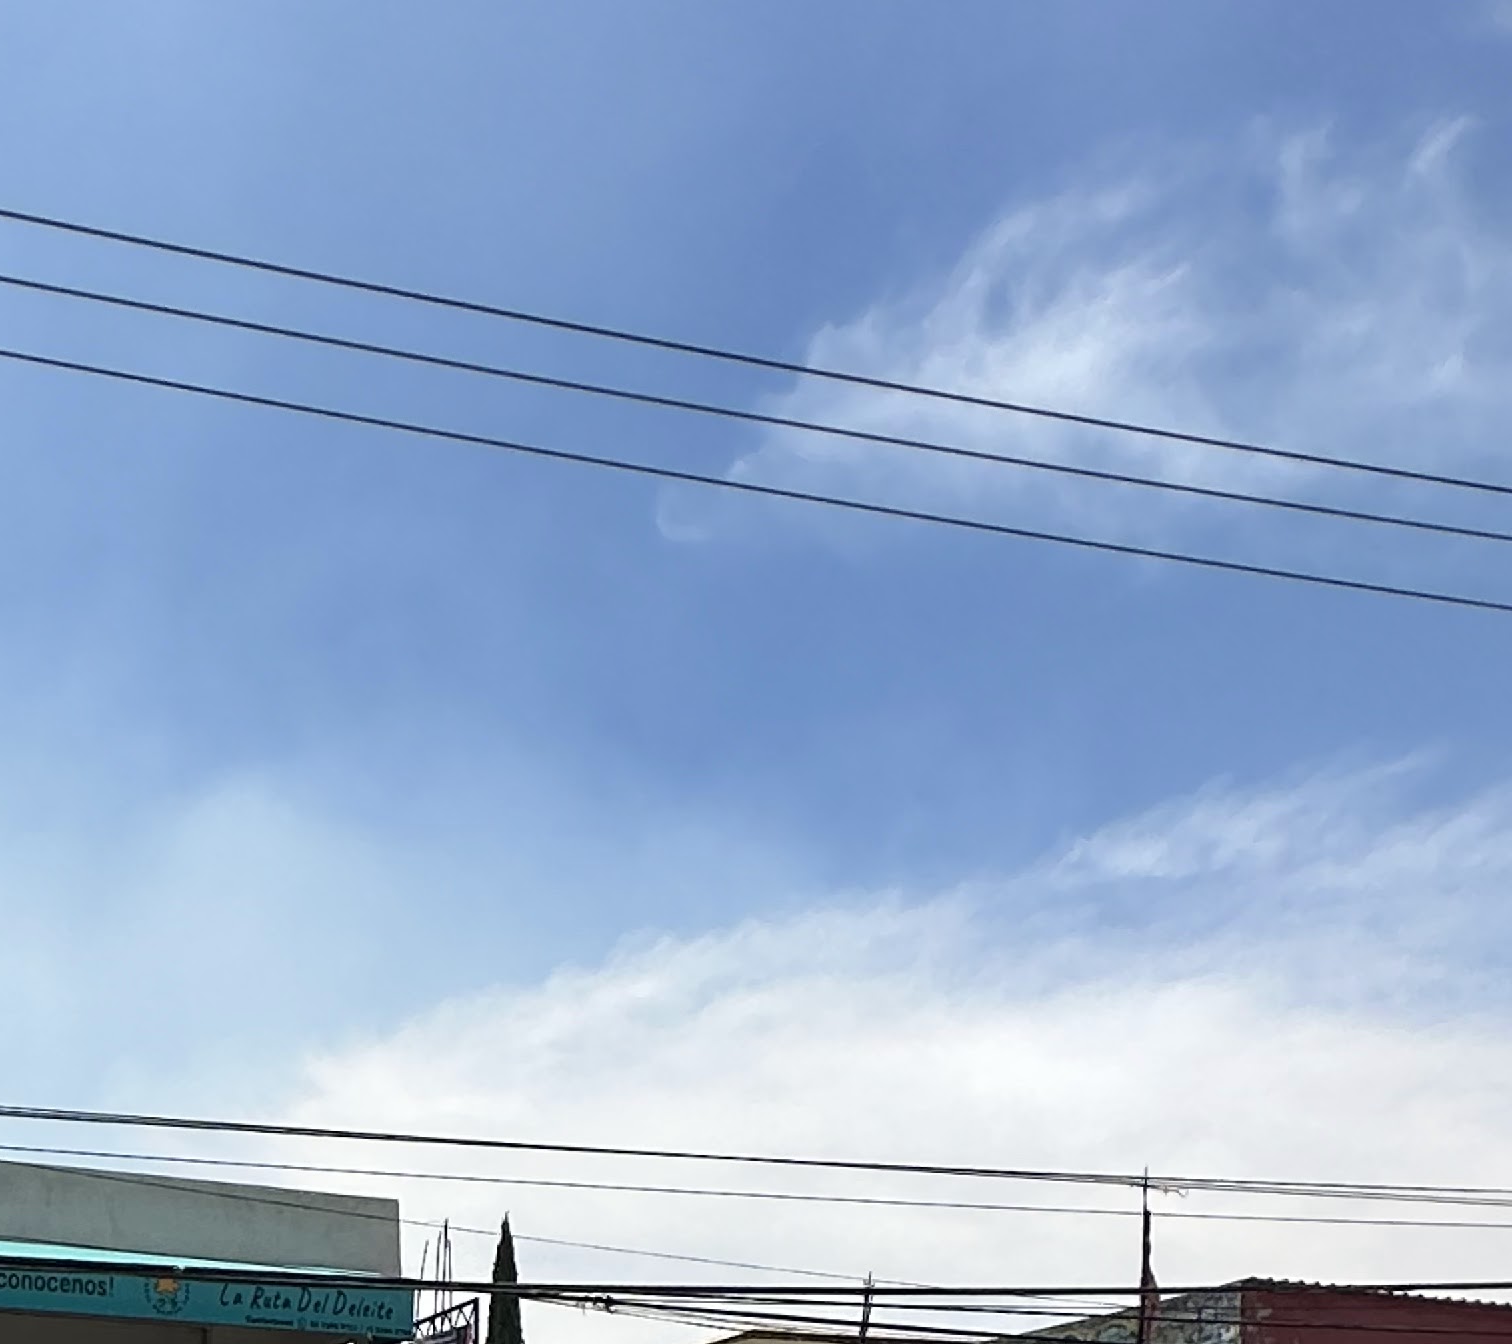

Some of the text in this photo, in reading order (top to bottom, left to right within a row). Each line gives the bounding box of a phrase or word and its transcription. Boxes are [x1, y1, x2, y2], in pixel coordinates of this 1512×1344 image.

[218, 1283, 243, 1306] La
[296, 1286, 330, 1313] Del
[332, 1290, 394, 1320] Deleite
